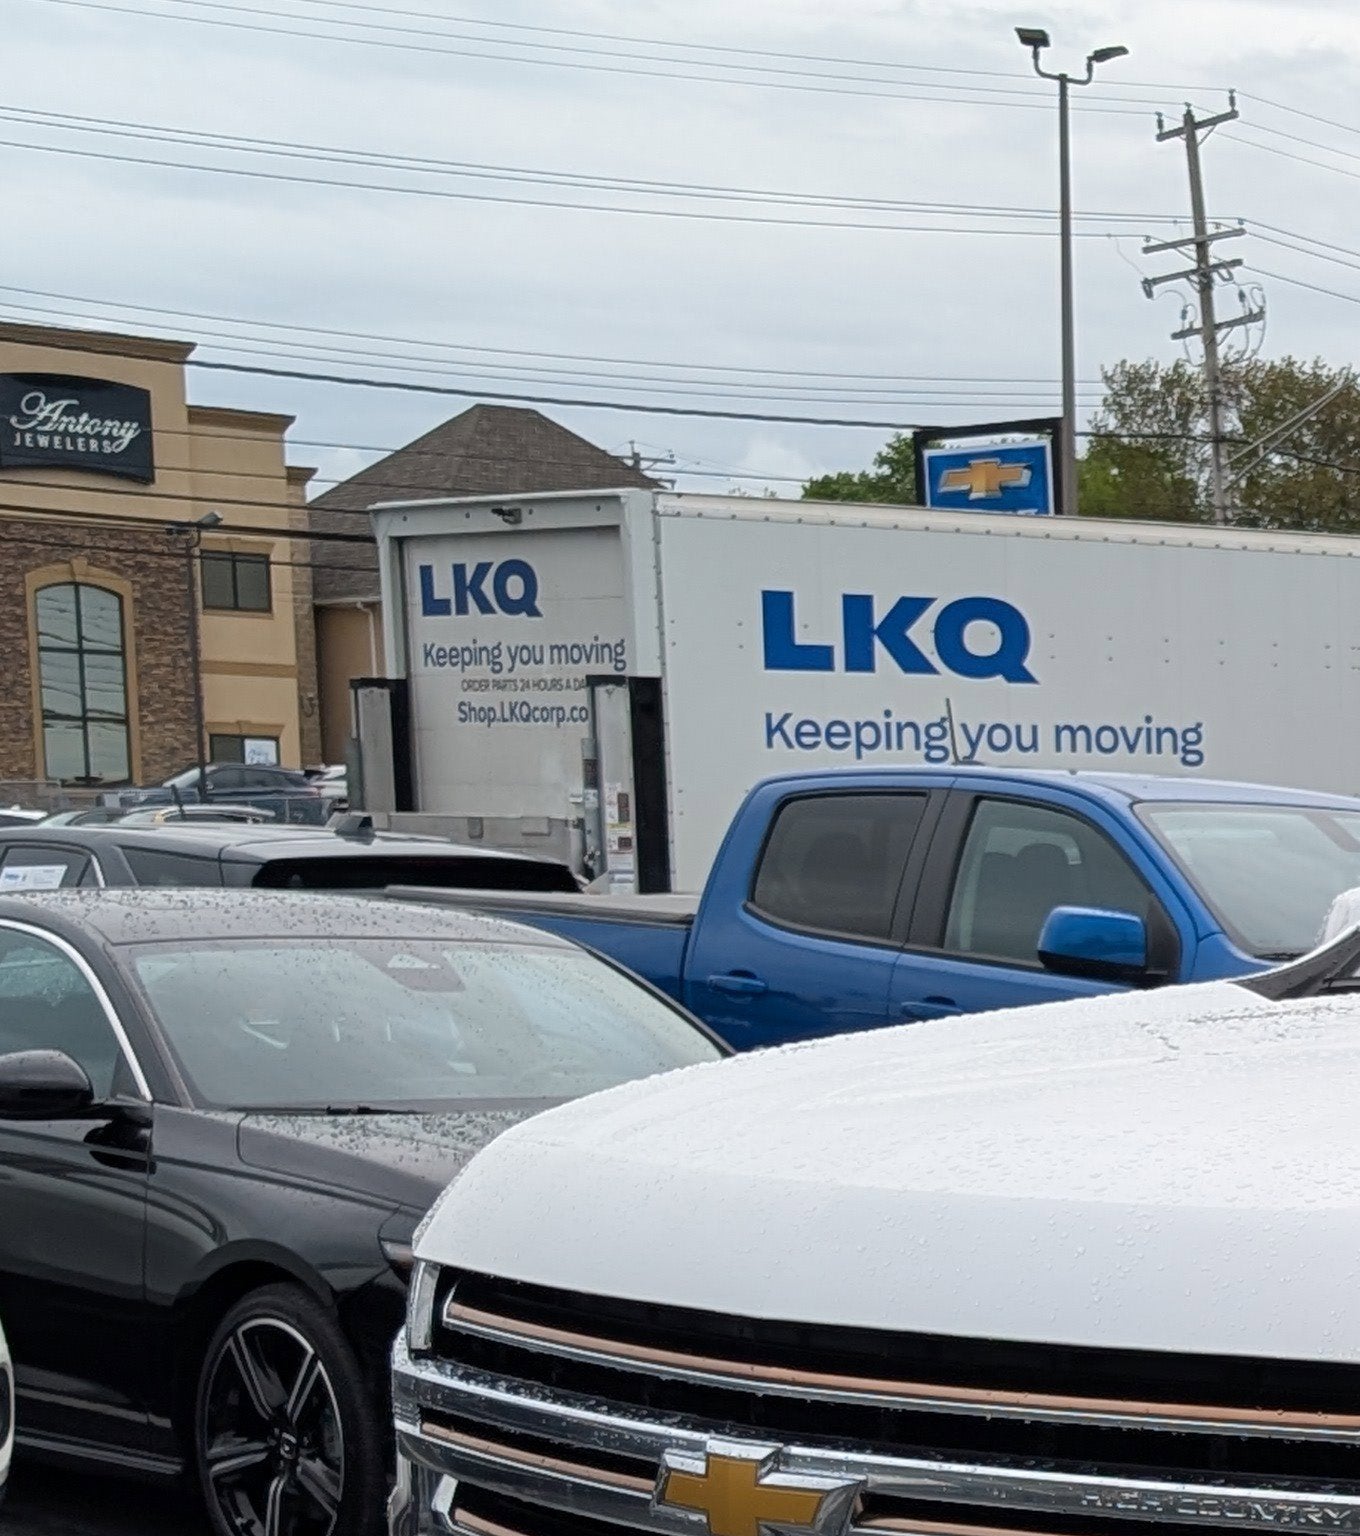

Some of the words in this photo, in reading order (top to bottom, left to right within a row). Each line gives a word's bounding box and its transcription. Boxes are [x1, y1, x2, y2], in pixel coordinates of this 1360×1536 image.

[10, 391, 141, 453] Antony
[14, 432, 112, 453] JEWELERS
[419, 559, 543, 617] LKQ
[423, 637, 503, 674] Keeping
[507, 644, 544, 672] you
[551, 635, 627, 671] moving
[761, 590, 1040, 684] LKQ
[461, 678, 490, 692] ORDER
[492, 678, 519, 692] PARTS
[532, 678, 564, 692] HOURS
[457, 701, 589, 728] Shop.LKQcorp.co
[765, 710, 949, 763] Keeping
[961, 720, 1039, 761] you
[1055, 715, 1204, 767] moving
[1176, 1498, 1353, 1526] COUNTRY
